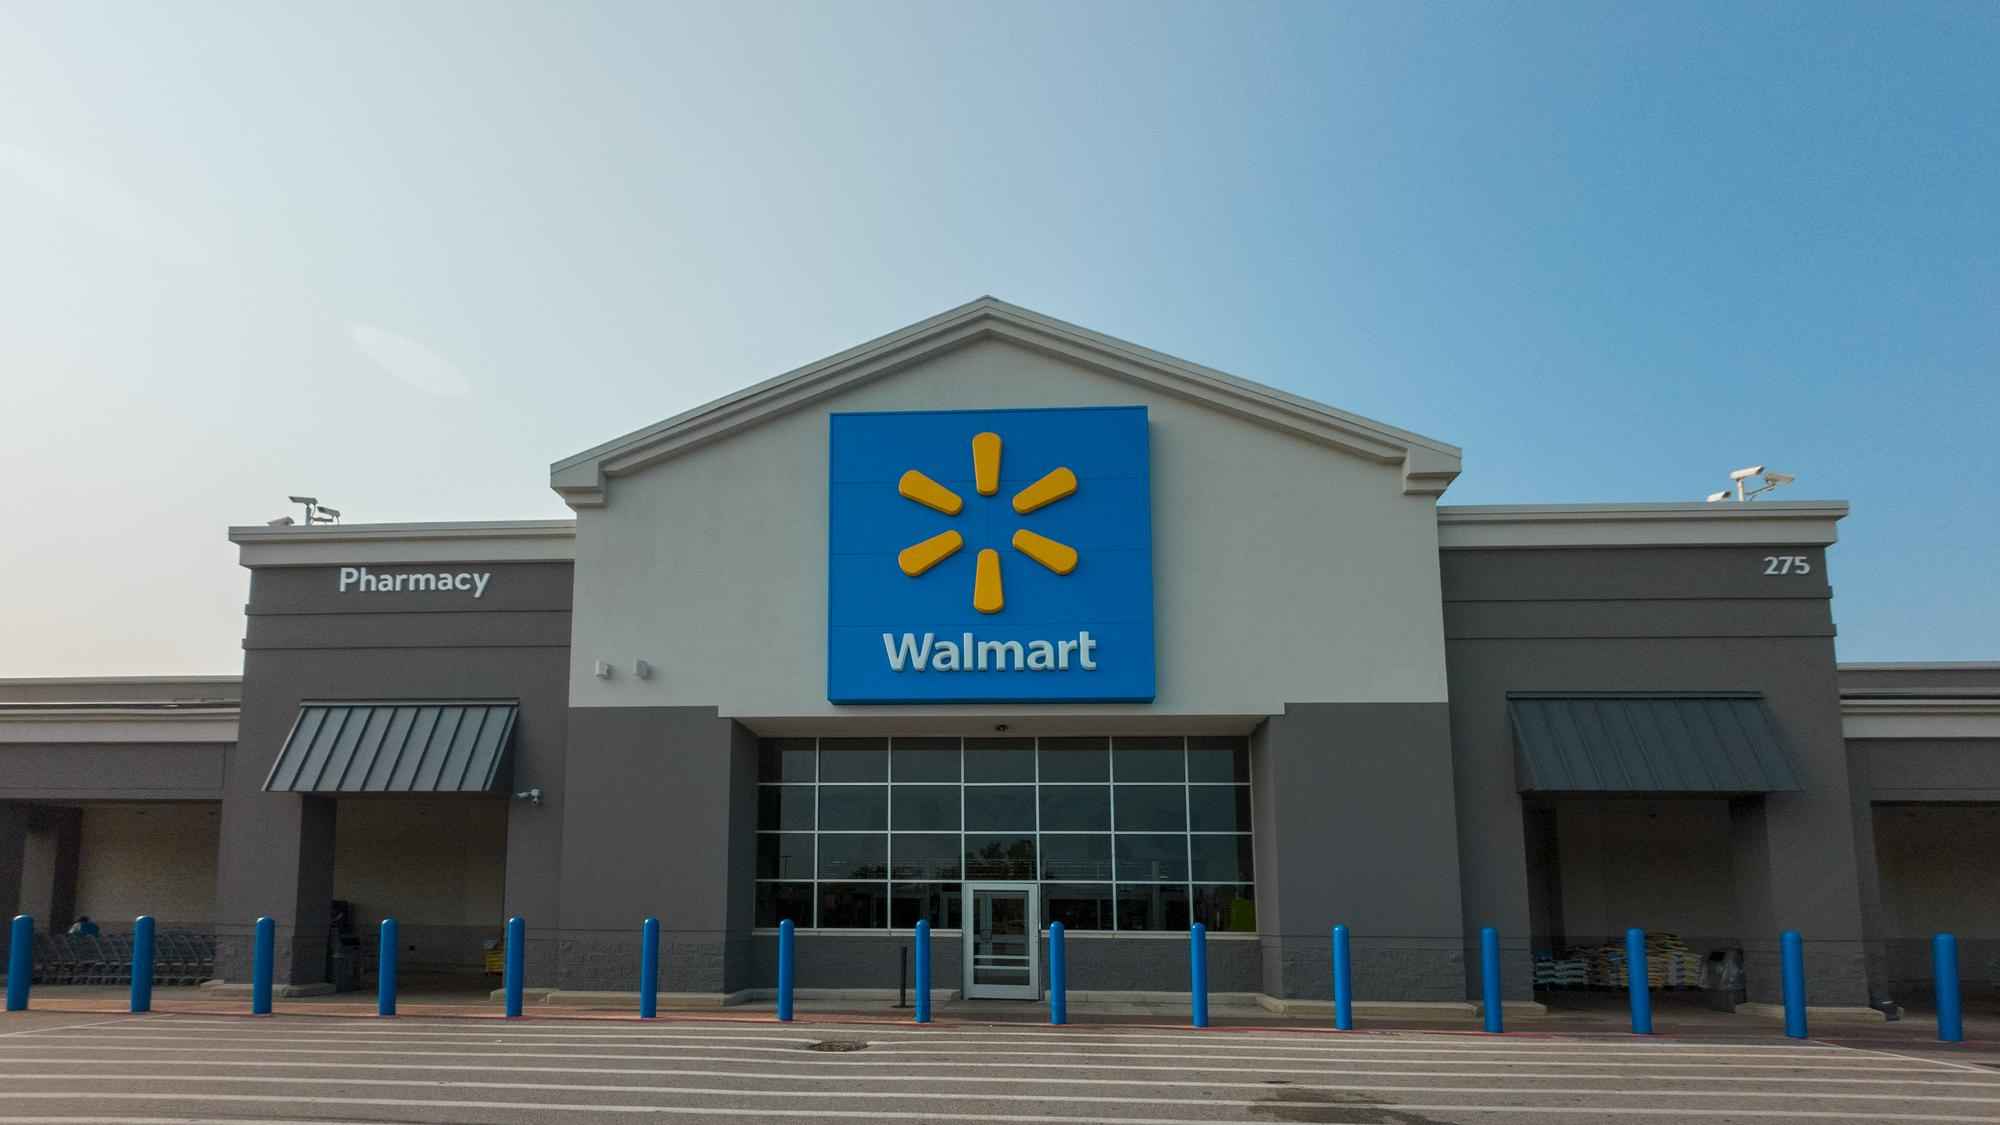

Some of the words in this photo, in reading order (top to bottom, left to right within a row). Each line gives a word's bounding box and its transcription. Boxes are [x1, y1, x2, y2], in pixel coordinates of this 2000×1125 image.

[1763, 556, 1810, 575] 275
[339, 567, 491, 598] Pharmacy
[882, 631, 1097, 672] Walmart
